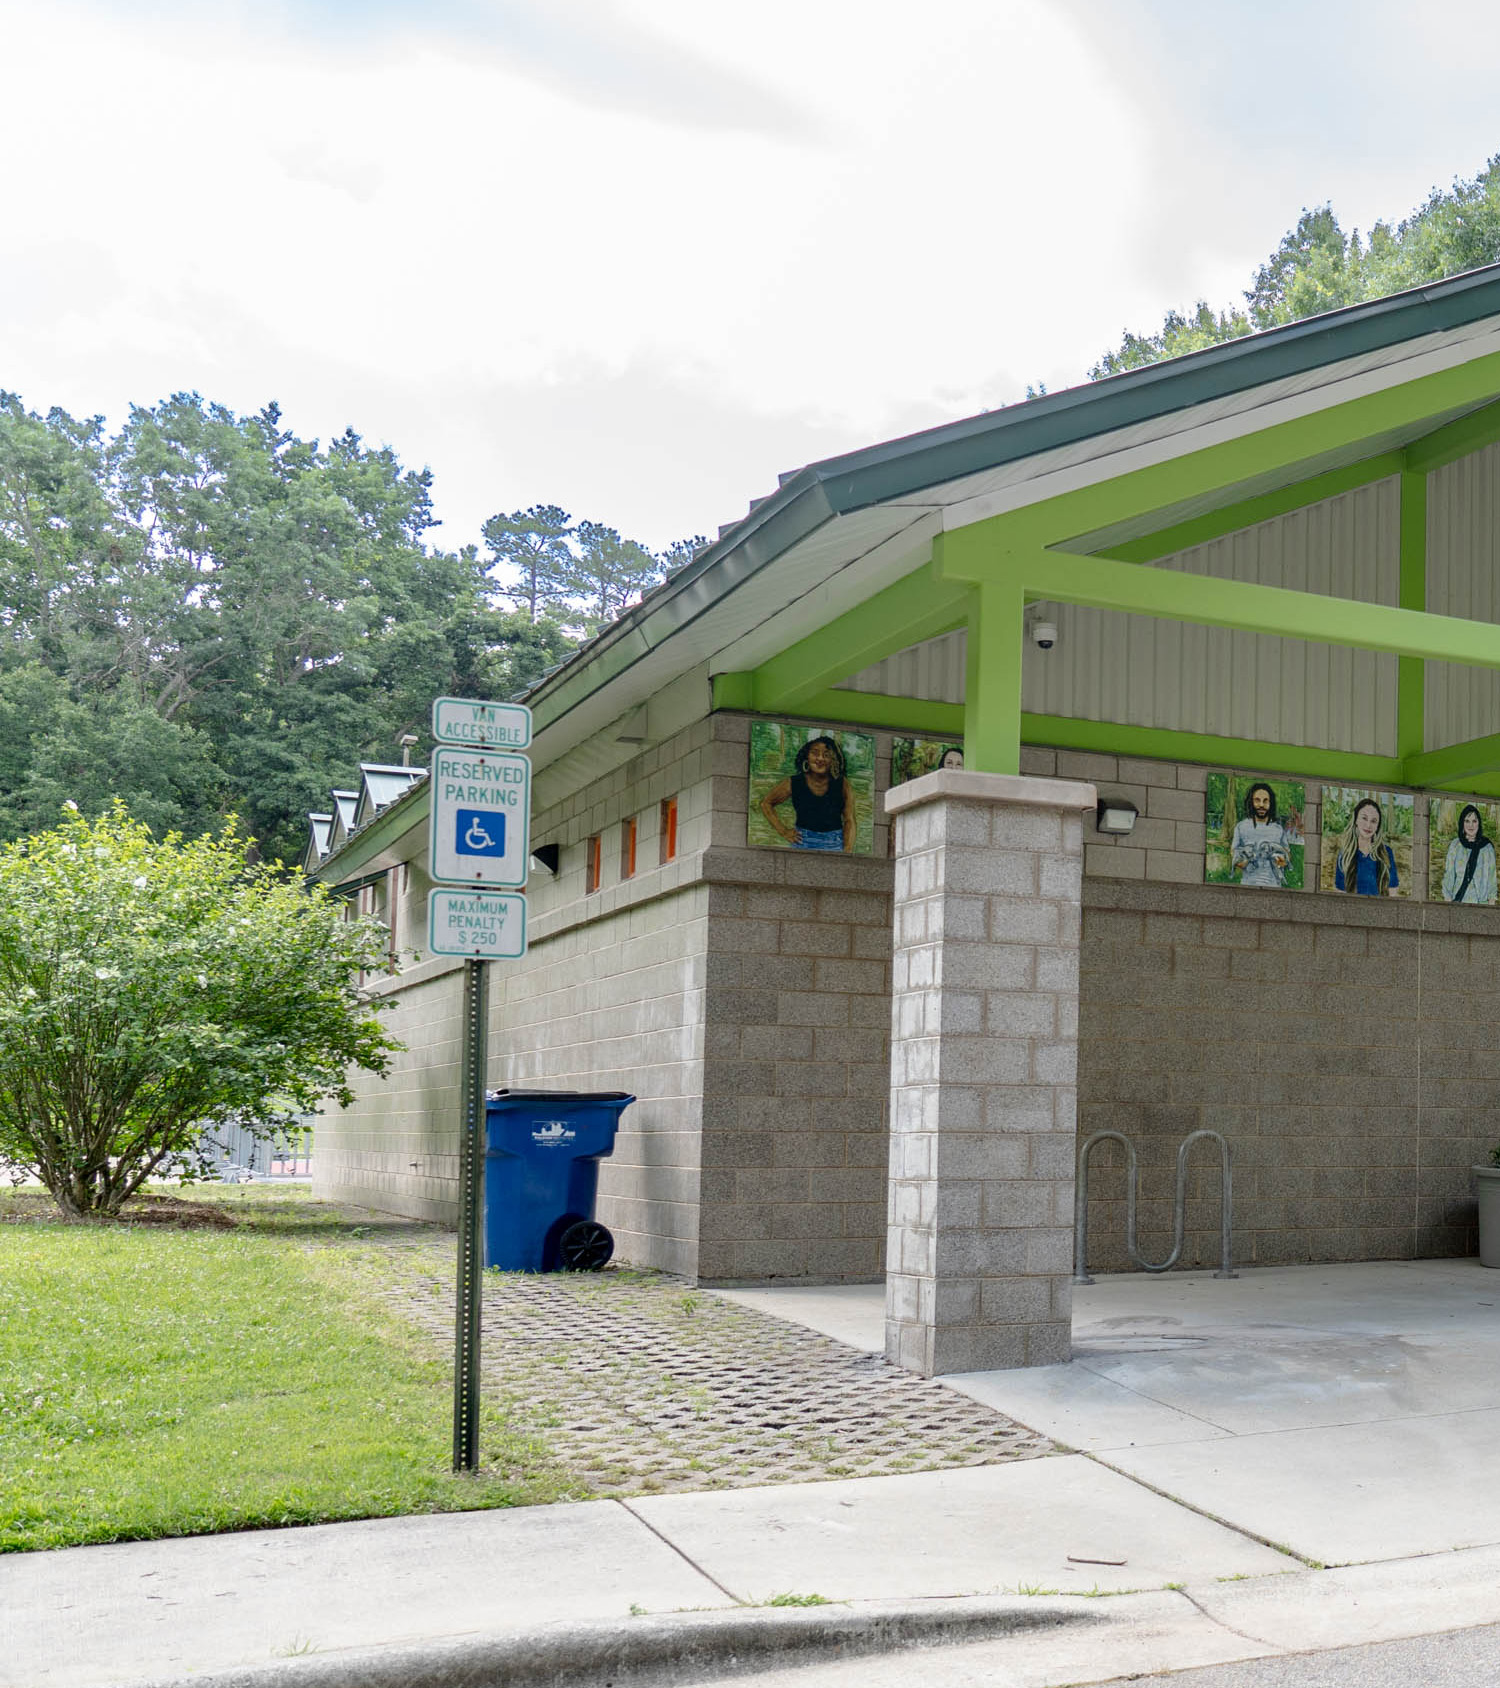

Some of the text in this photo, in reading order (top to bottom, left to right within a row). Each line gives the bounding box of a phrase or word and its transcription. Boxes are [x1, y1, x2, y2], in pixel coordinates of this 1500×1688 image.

[472, 708, 495, 723] VAN
[445, 722, 520, 742] ACCESSIBLE
[440, 761, 523, 784] RESERVED
[445, 784, 518, 806] PARKING
[448, 900, 508, 914] MAXIMUM
[448, 915, 505, 929] PENALTY
[471, 932, 497, 945] 250
